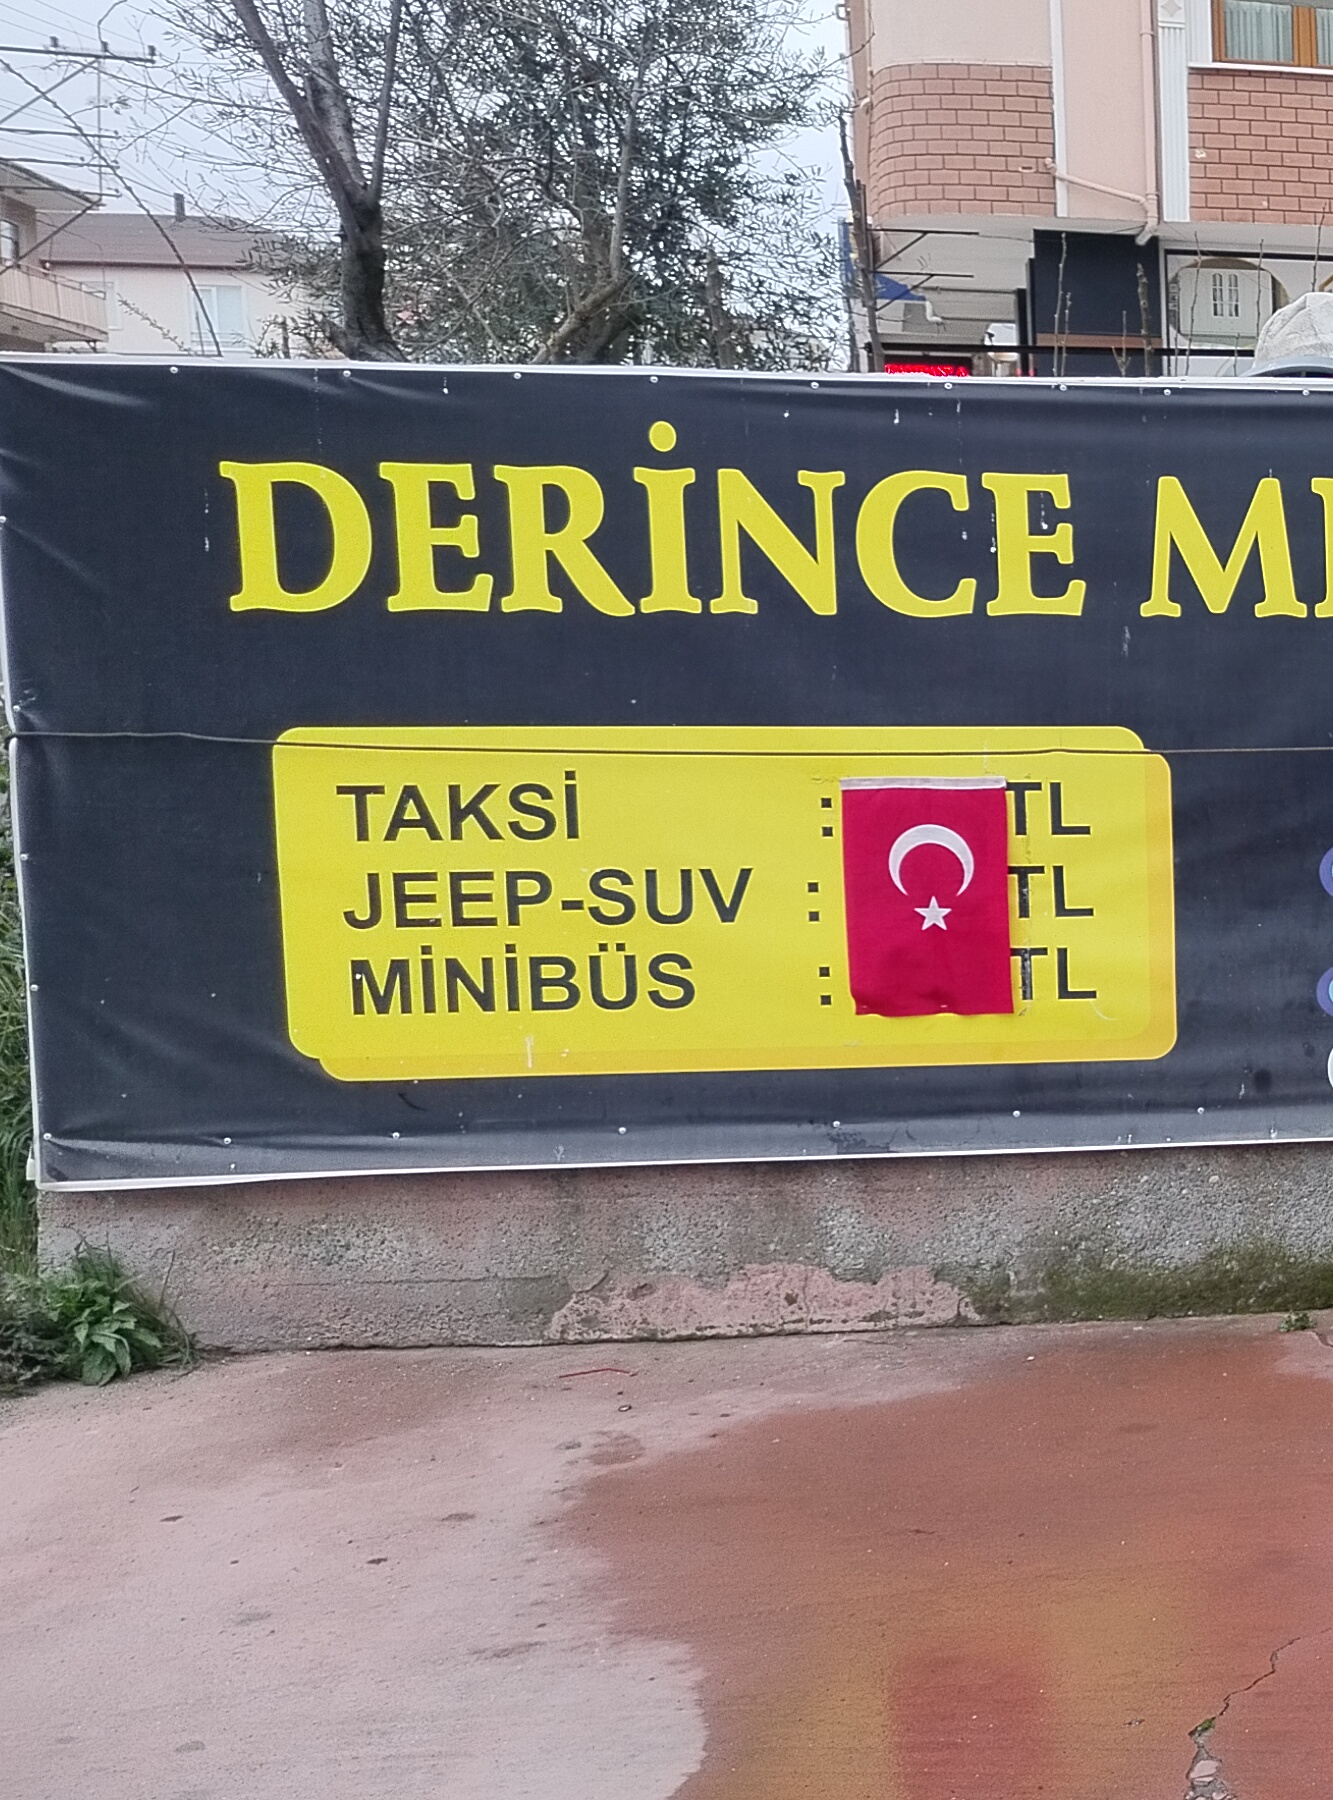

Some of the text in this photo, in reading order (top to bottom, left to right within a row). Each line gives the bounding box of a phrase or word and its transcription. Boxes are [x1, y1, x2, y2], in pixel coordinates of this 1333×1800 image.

[217, 420, 1088, 618] DERİNCE
[335, 770, 579, 842] TAKSİ
[1004, 781, 1091, 836] TL
[343, 867, 753, 930] JEEP-SUV
[1007, 865, 1094, 919] TL
[350, 942, 695, 1015] MİNİBÜS
[1009, 947, 1097, 1001] TL
